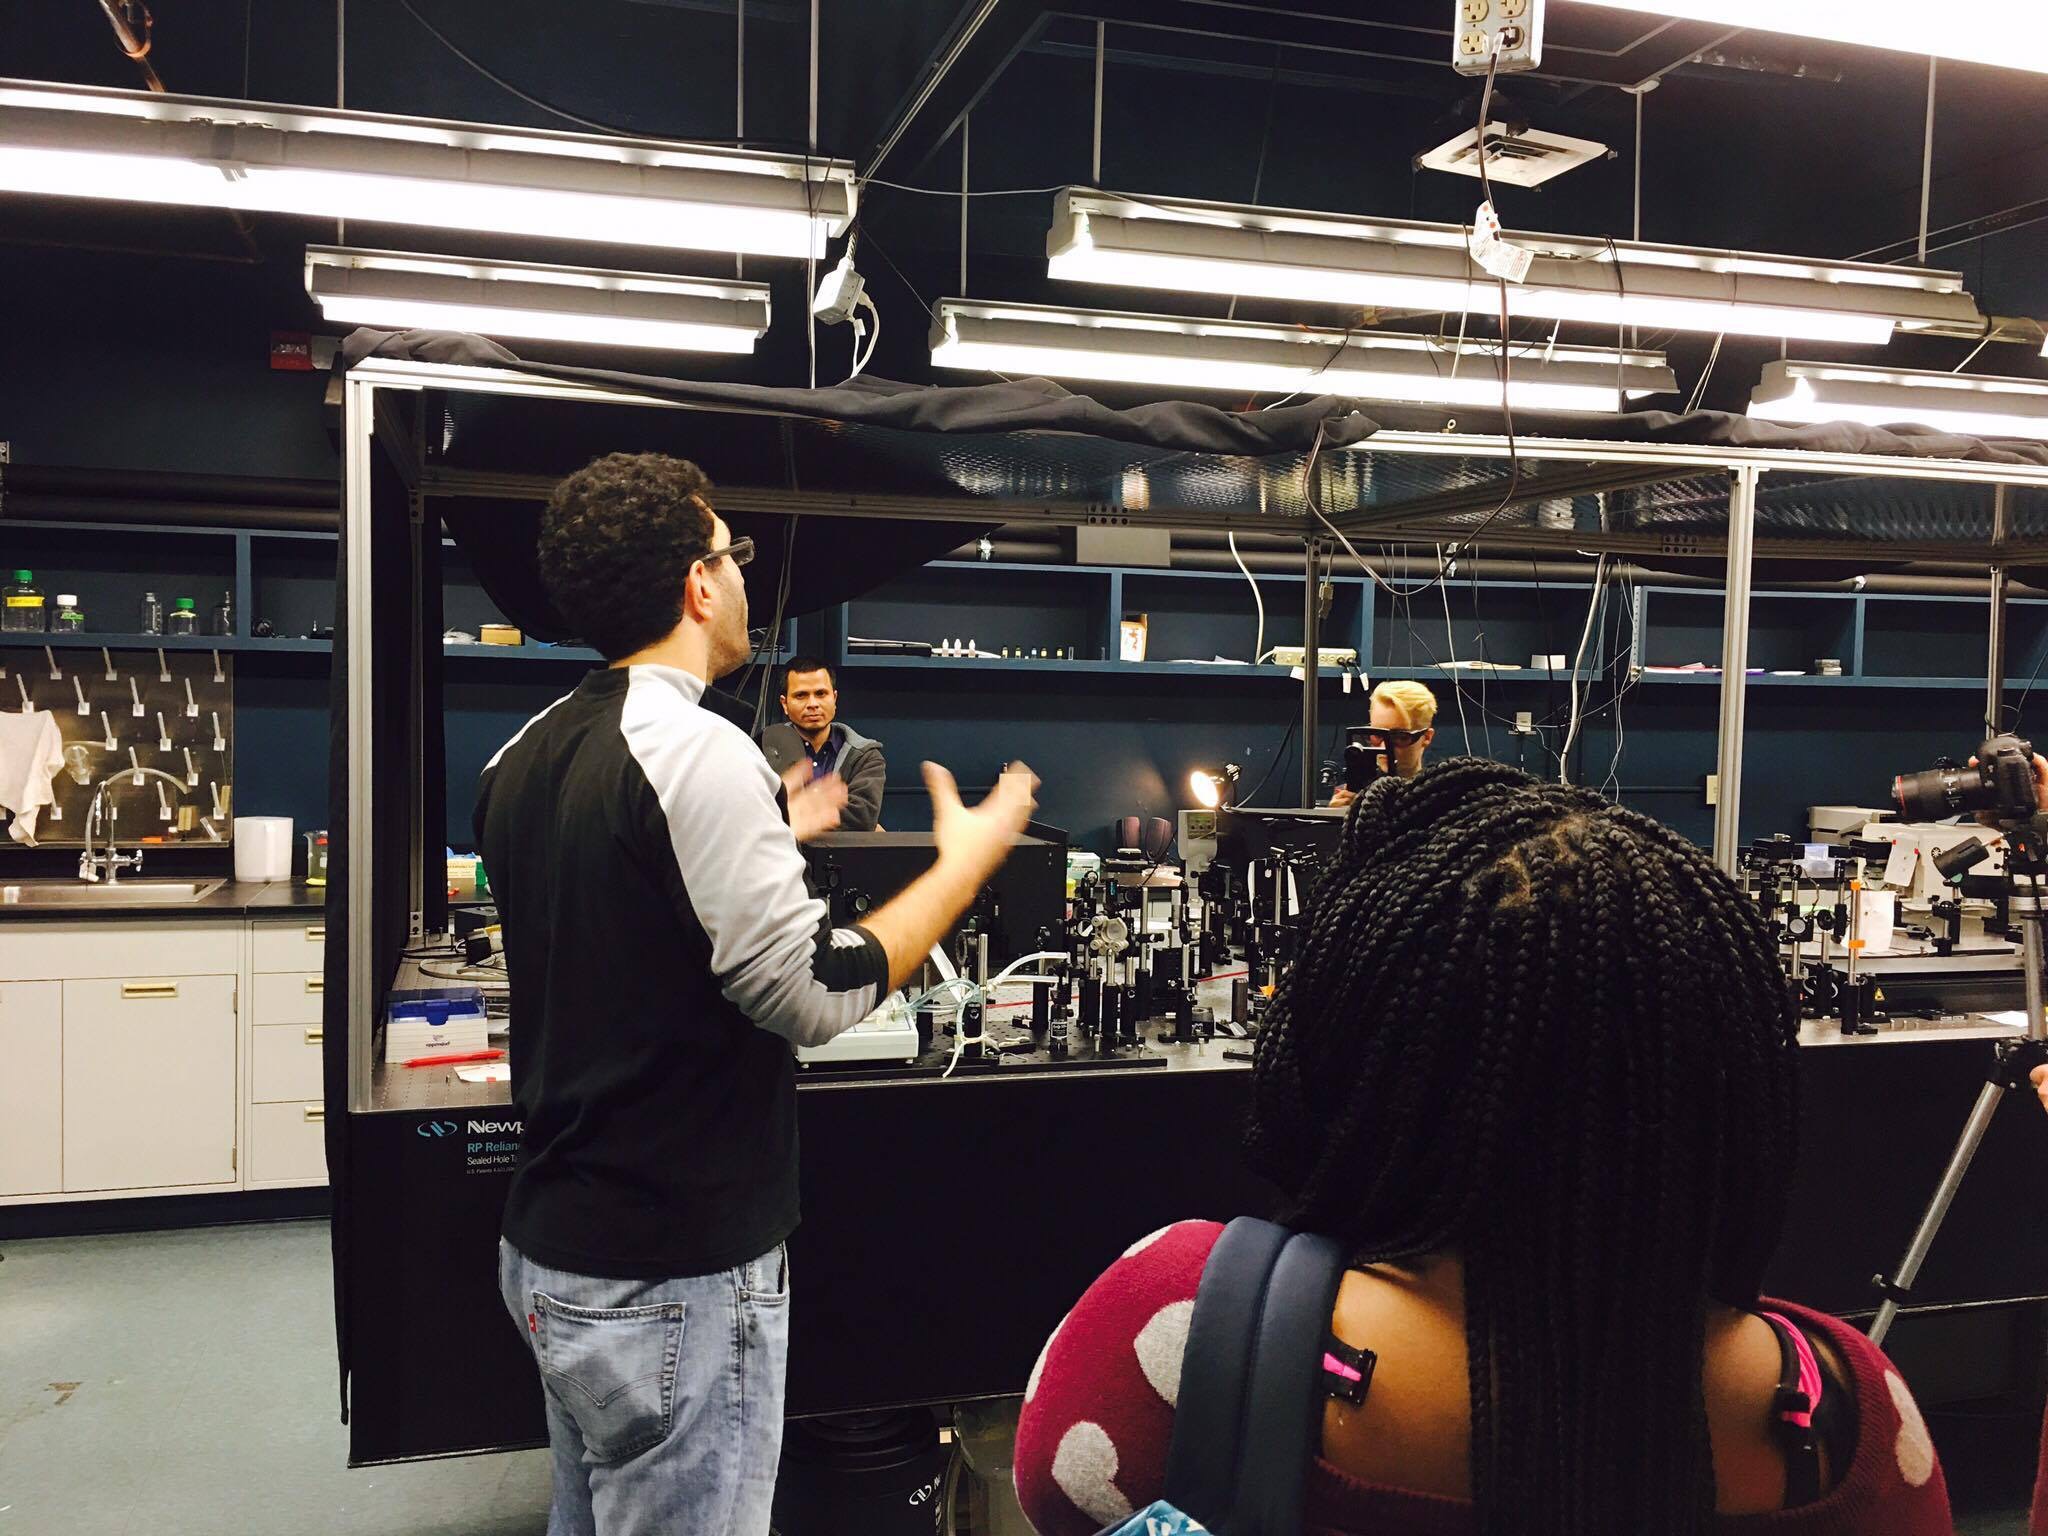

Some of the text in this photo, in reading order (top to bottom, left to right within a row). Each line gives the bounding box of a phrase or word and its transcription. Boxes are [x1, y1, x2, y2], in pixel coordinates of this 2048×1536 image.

[467, 1141, 520, 1153] RP Relian
[467, 1155, 492, 1166] Sealed
[493, 1155, 510, 1164] Hole
